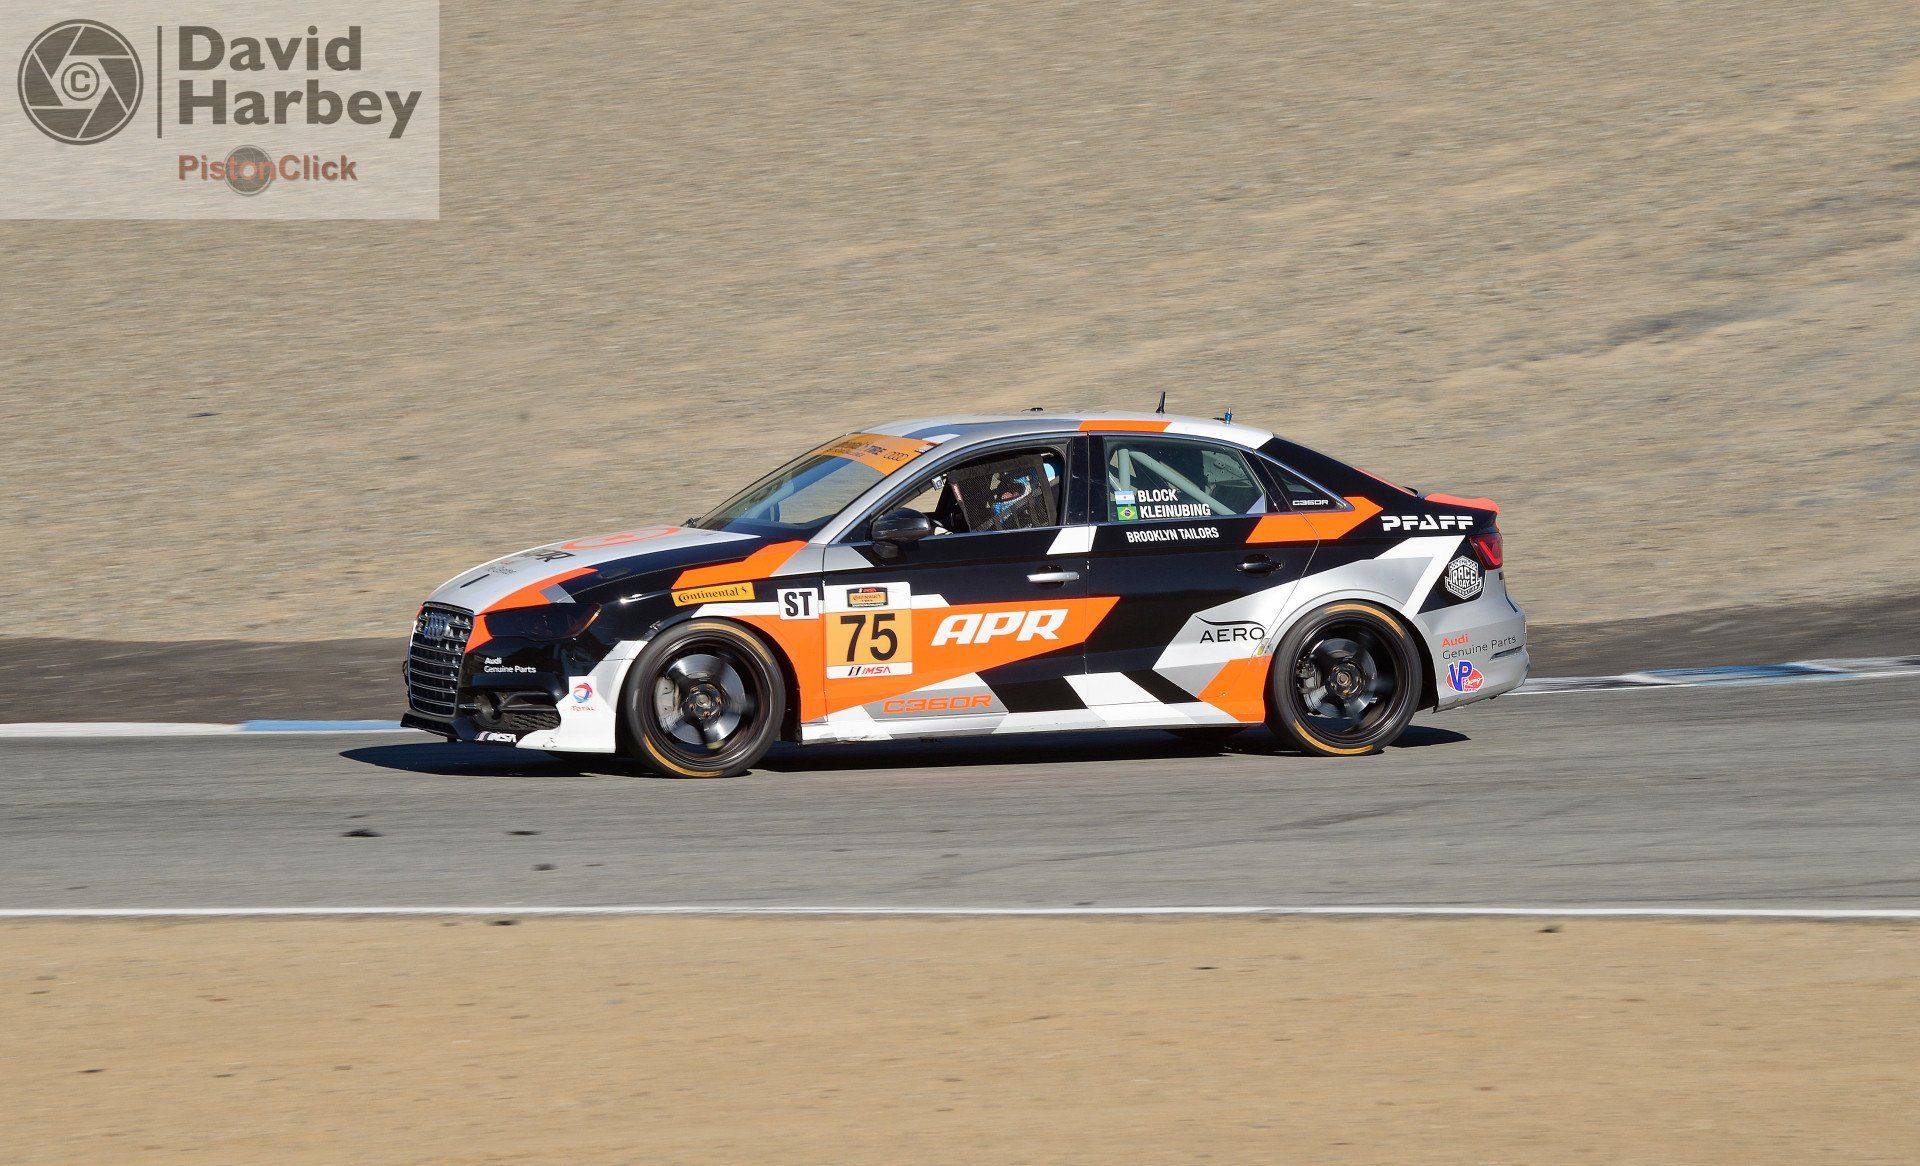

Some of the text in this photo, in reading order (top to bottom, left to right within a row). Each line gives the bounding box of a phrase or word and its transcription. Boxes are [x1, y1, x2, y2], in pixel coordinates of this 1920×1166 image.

[1137, 489, 1178, 502] BLOCK
[1139, 503, 1212, 519] KLEINUBING
[1380, 514, 1474, 532] PFAFF
[1126, 527, 1220, 543] BROOKLYN TAILORS
[1452, 566, 1476, 586] RACE
[678, 587, 738, 604] Continental
[784, 591, 813, 617] ST
[931, 609, 1068, 646] APR
[1200, 627, 1265, 644] AERO
[840, 612, 898, 662] 75
[1441, 634, 1470, 648] Audi
[1442, 635, 1517, 660] Genuine Parts
[483, 665, 537, 674] Genuine Parts
[484, 657, 502, 665] Audi
[861, 666, 891, 675] IMSA
[1448, 660, 1473, 692] VP
[883, 695, 992, 713] C360R
